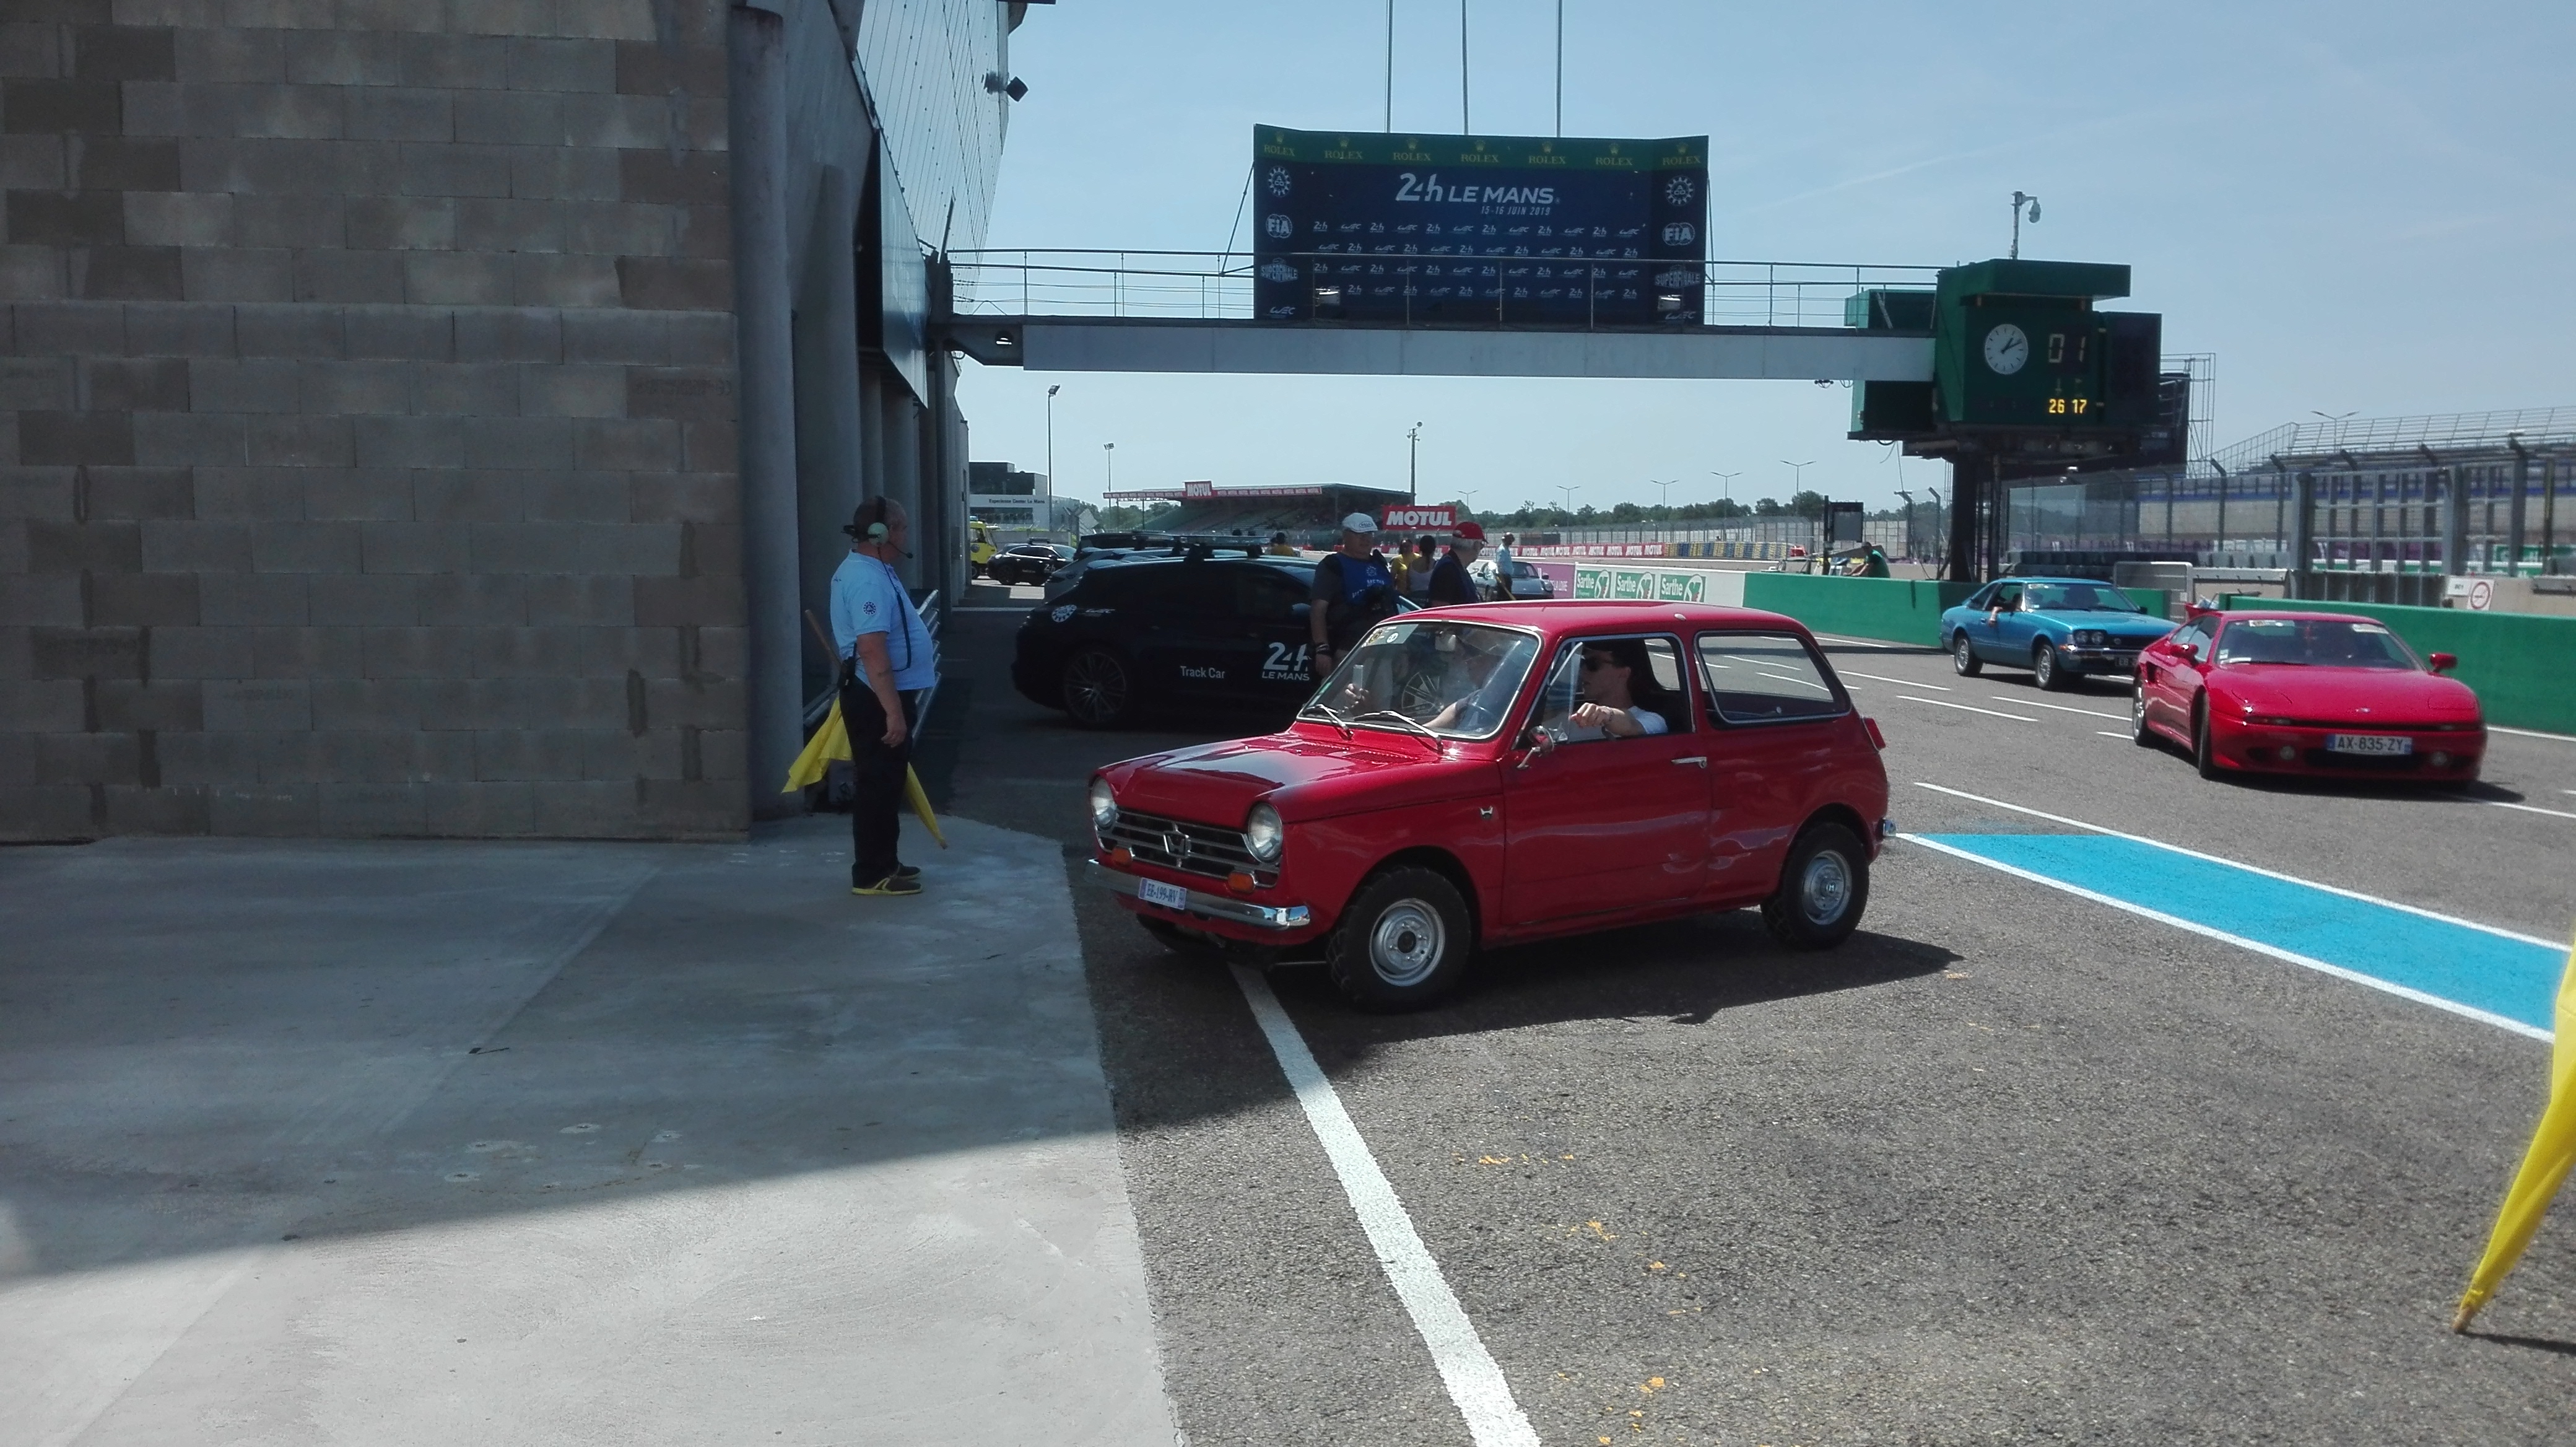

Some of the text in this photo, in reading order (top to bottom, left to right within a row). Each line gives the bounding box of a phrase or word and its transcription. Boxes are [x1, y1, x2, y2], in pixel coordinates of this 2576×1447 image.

[1264, 144, 1295, 157] ROLEX
[1325, 150, 1363, 160] ROLEX
[1393, 152, 1432, 161] ROLEX
[1461, 154, 1499, 163] ROLEX
[1528, 155, 1567, 164] ROLEX
[1596, 157, 1634, 165] ROLEX
[1663, 155, 1702, 165] ROLEX
[1448, 186, 1480, 202] LE
[1482, 186, 1554, 204] MANS
[1481, 206, 1551, 216] 15-16 JUIN 2019
[2048, 398, 2087, 414] 26 17
[1187, 482, 1212, 497] MOTUL
[1386, 511, 1452, 526] MOTUL
[1577, 572, 1595, 589] Sarthe
[1617, 575, 1636, 593] Sarthe
[1661, 578, 1683, 596] Sarthe
[1180, 665, 1225, 679] Track Car
[1262, 671, 1310, 681] LE MANS
